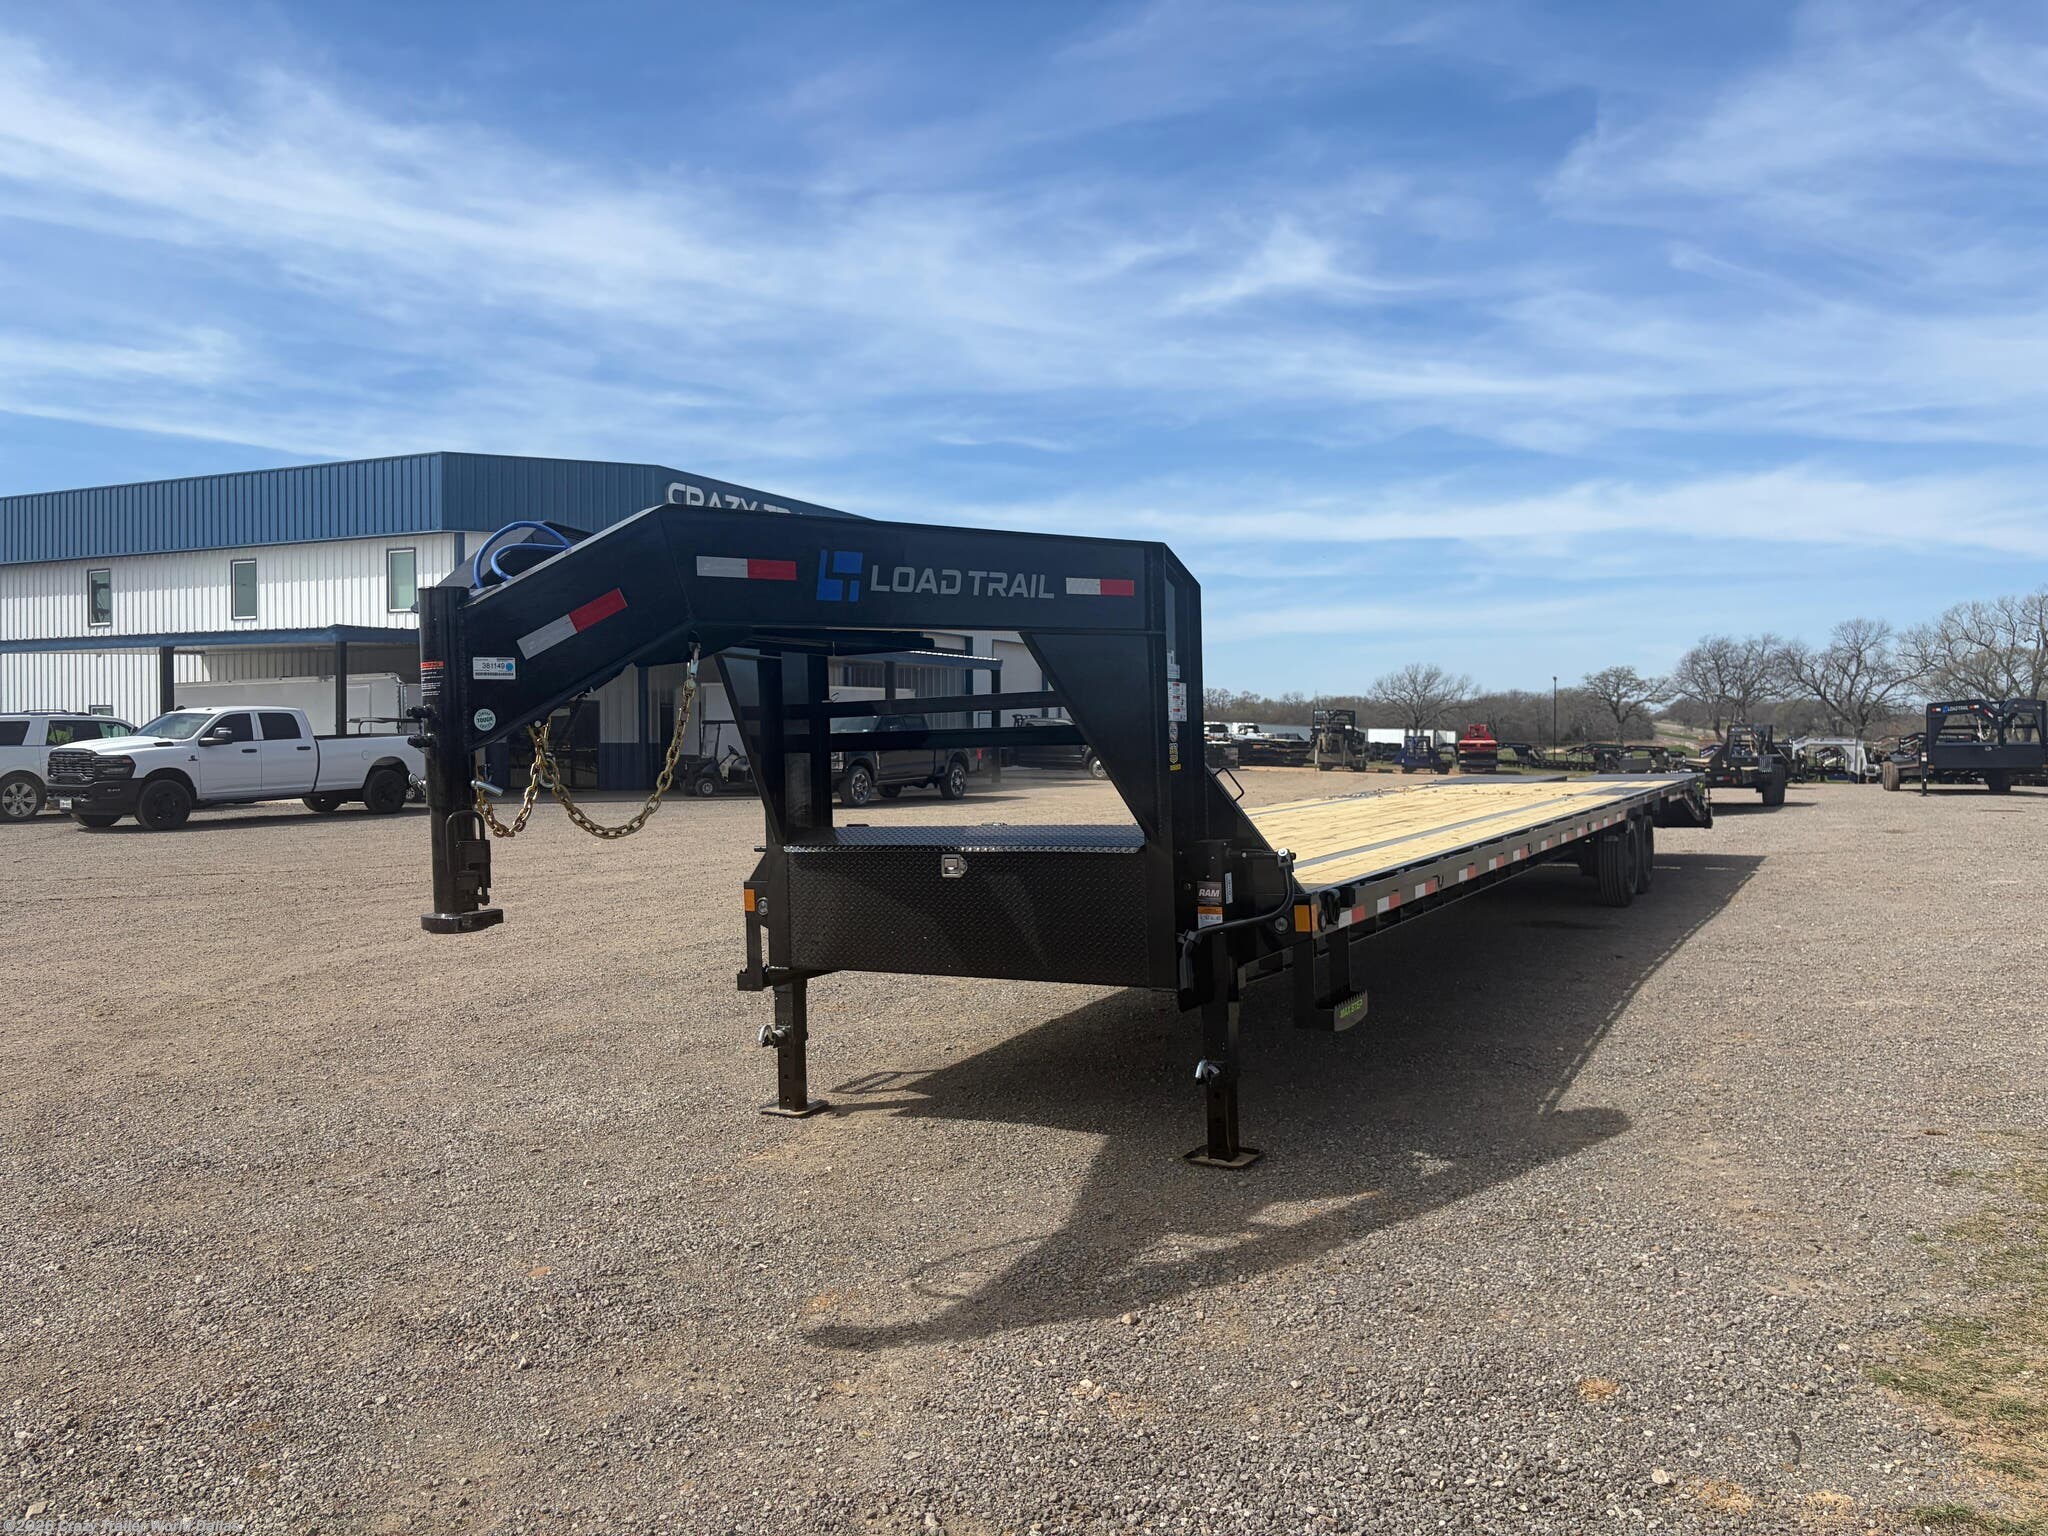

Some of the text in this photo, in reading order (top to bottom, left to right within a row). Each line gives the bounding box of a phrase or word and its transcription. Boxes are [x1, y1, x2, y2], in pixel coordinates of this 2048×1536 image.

[870, 565, 1055, 599] LOAD TRAIL
[1199, 889, 1220, 897] RAM
